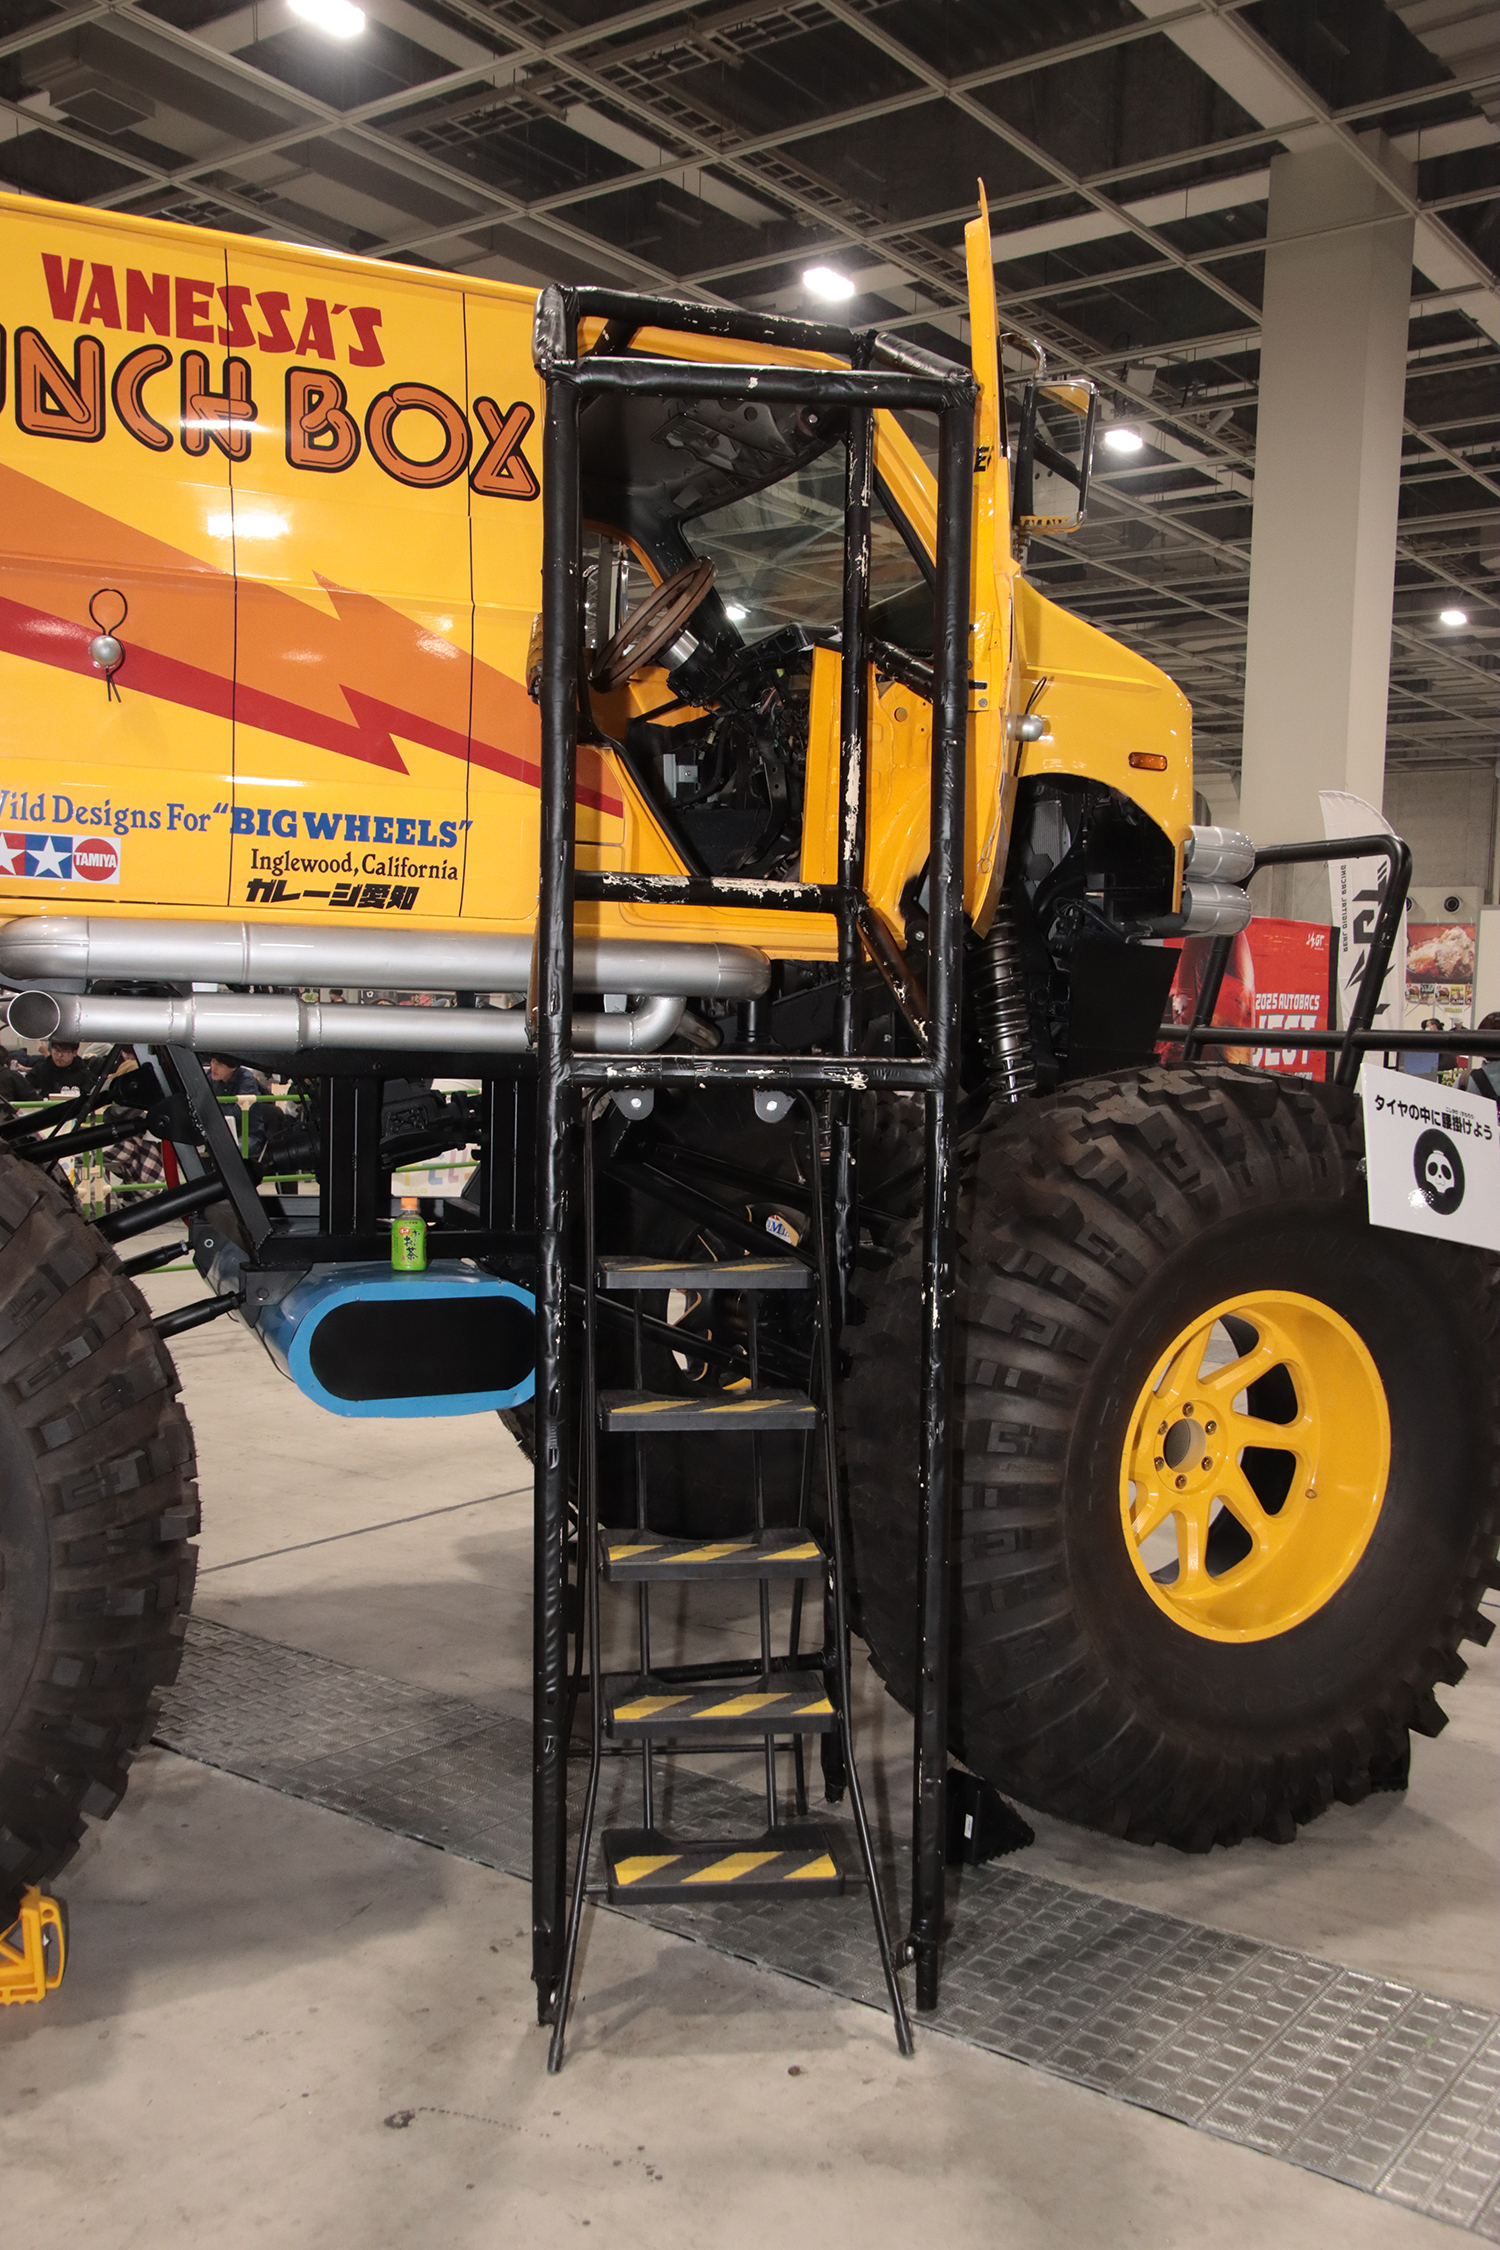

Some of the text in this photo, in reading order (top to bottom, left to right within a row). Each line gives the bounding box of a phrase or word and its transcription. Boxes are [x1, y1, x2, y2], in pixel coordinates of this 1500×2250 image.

[41, 252, 386, 368] VANESSA'S
[0, 323, 541, 501] NCH BOX
[52, 794, 162, 836] Designs
[166, 802, 211, 832] For
[74, 851, 118, 869] TAMIYA
[251, 848, 459, 881] Inglewood, California
[245, 877, 421, 911] ガレージ愛知
[1255, 992, 1320, 1011] 2025 AUTOBACS
[1375, 1094, 1492, 1140] タイヤの中に腰掛けよう
